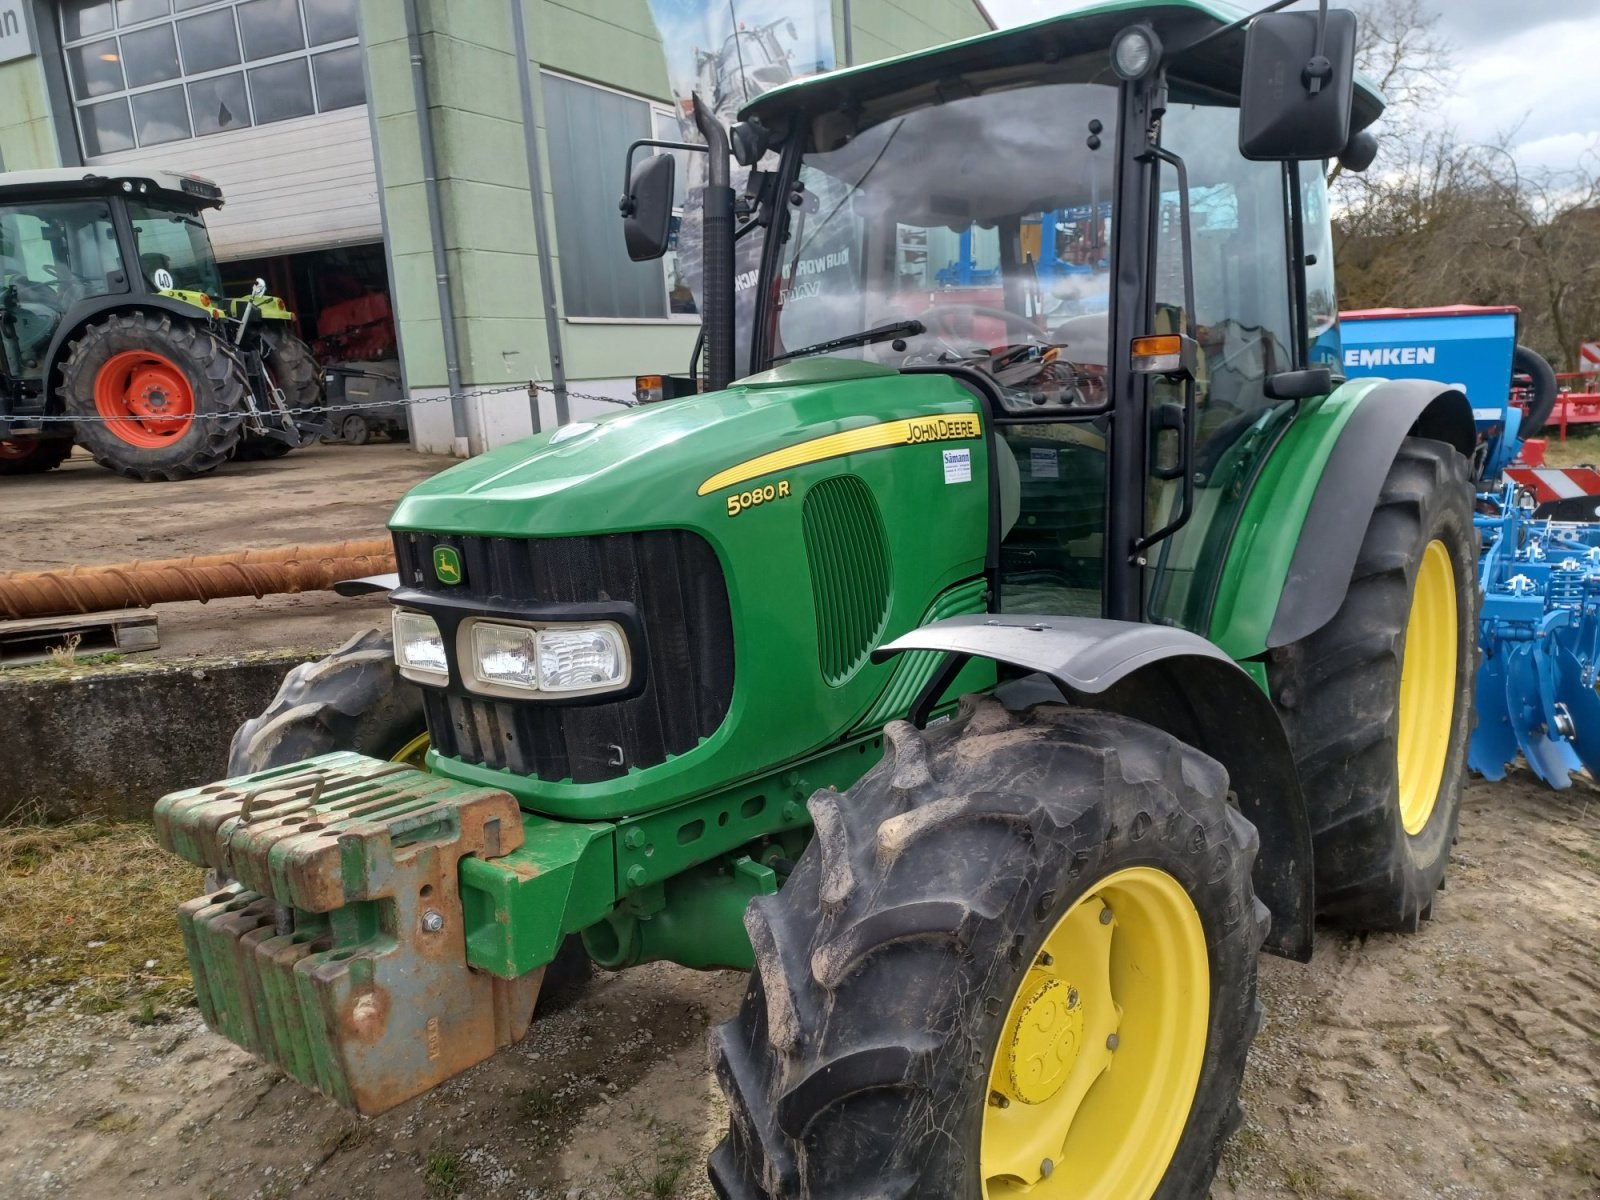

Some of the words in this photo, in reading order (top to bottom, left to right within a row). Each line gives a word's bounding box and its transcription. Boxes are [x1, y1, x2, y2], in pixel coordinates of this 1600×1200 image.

[158, 273, 170, 288] 40
[1344, 347, 1436, 369] EMKEN
[907, 422, 938, 443] JOHN
[939, 419, 974, 438] DEERE
[727, 483, 775, 516] 5080
[778, 480, 790, 497] R
